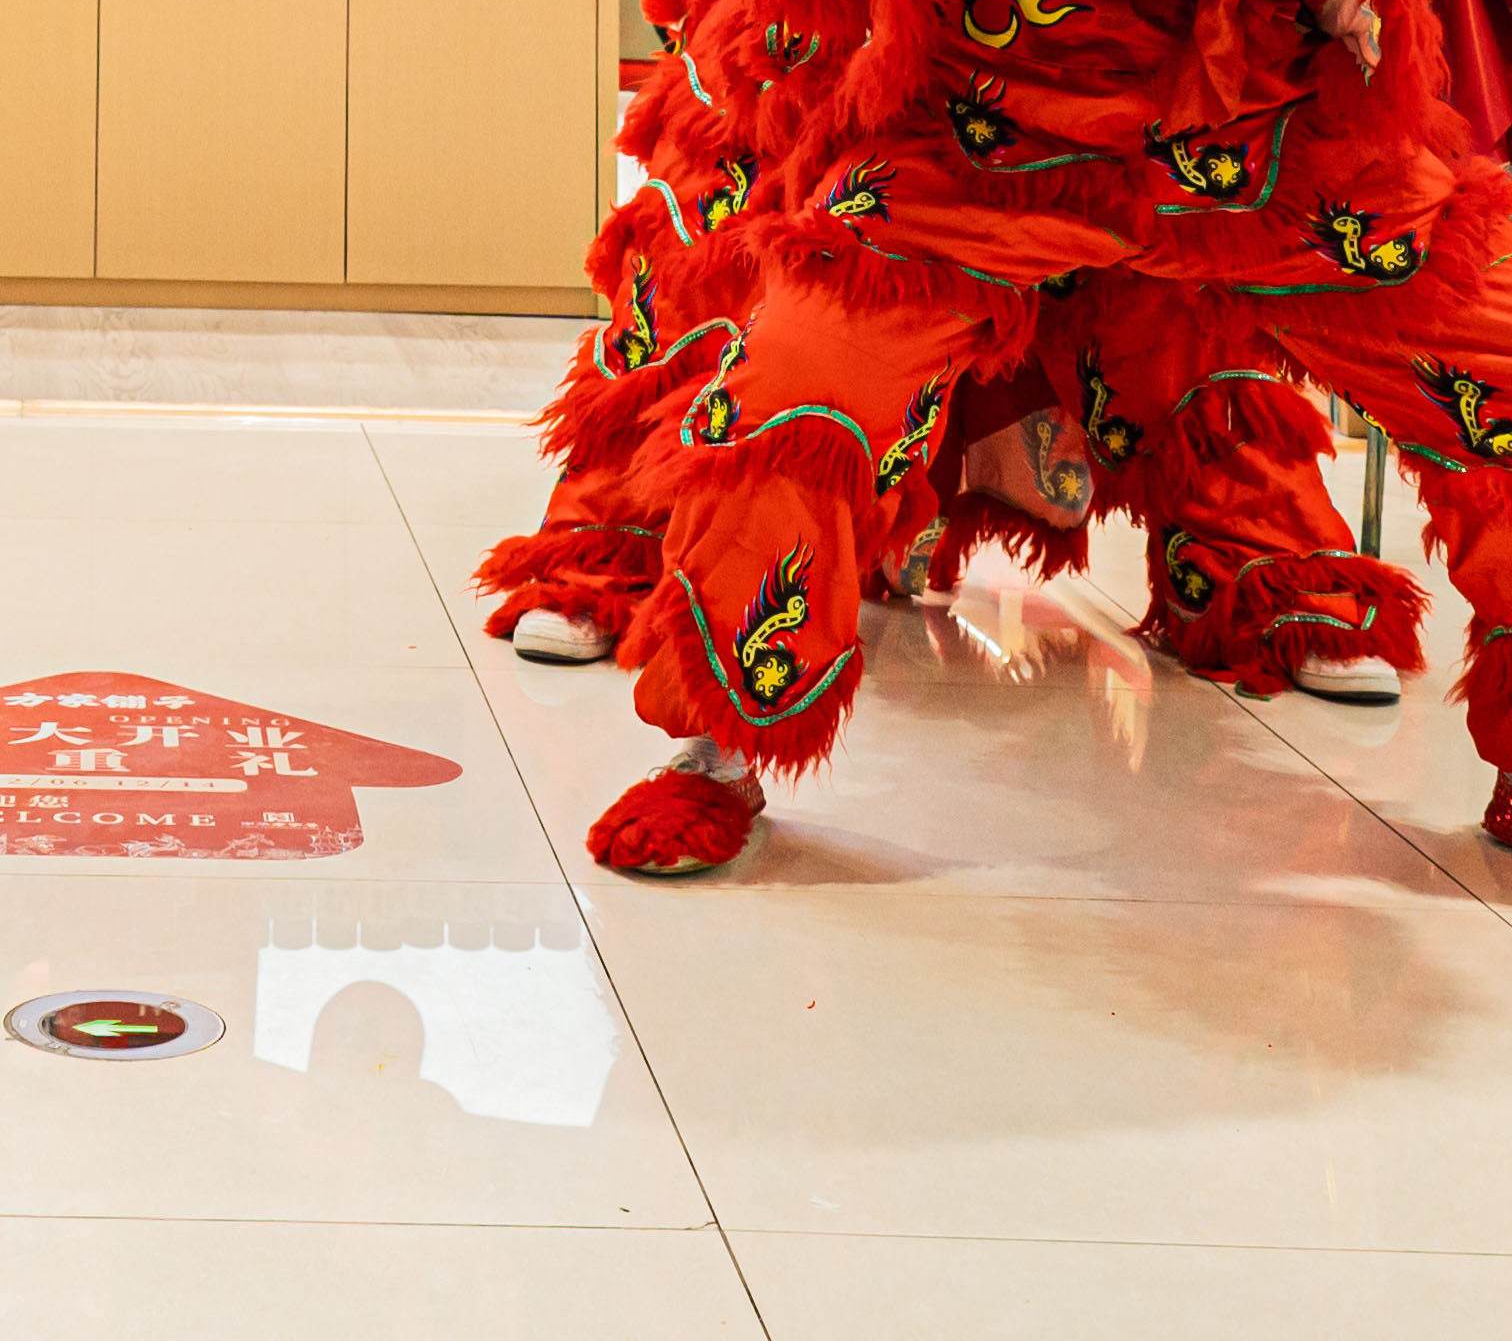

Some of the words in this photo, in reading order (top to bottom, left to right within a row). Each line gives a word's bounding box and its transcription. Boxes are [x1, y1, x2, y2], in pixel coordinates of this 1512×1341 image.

[3, 692, 195, 710] 方家铺子
[109, 715, 291, 727] OPENING
